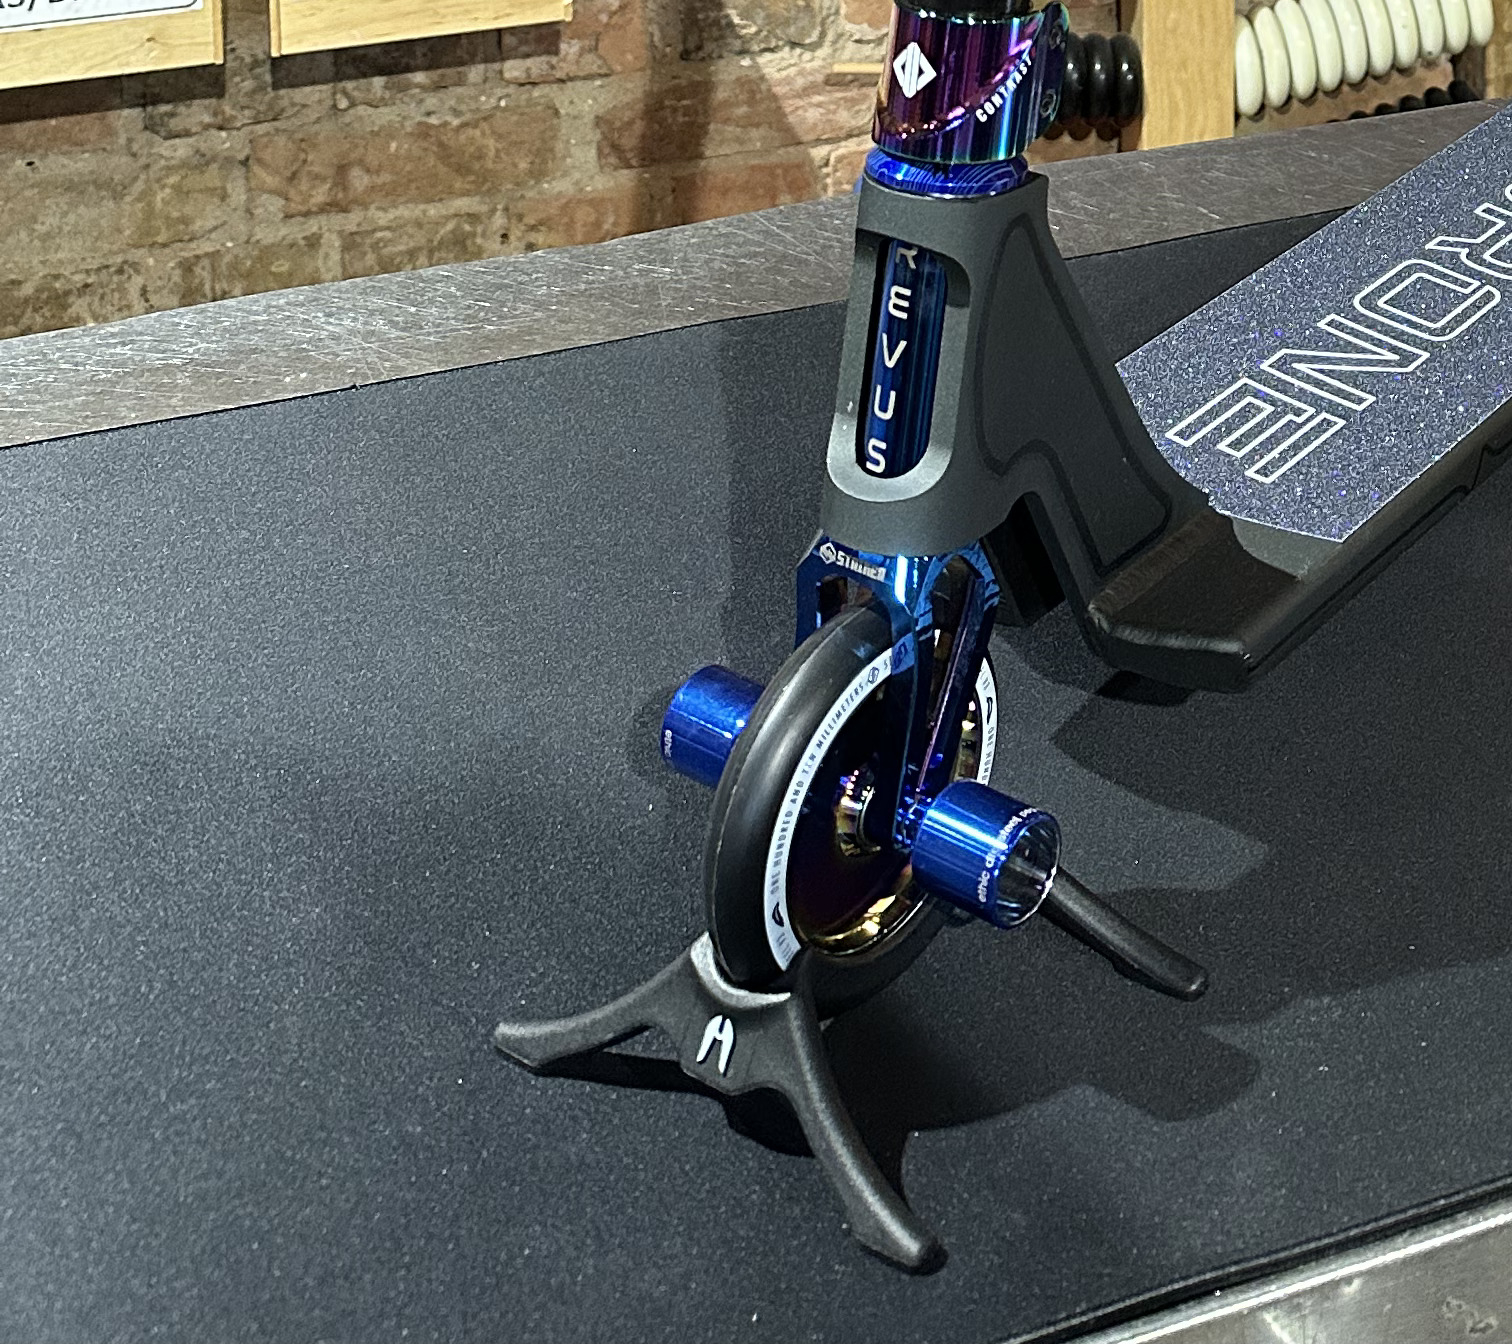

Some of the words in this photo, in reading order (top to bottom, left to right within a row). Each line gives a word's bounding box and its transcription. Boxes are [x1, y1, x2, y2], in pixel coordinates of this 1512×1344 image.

[975, 50, 1032, 123] CONTRAST
[771, 810, 794, 871] HUNDRED
[790, 779, 805, 805] AND
[815, 683, 865, 750] MILLIMETERS
